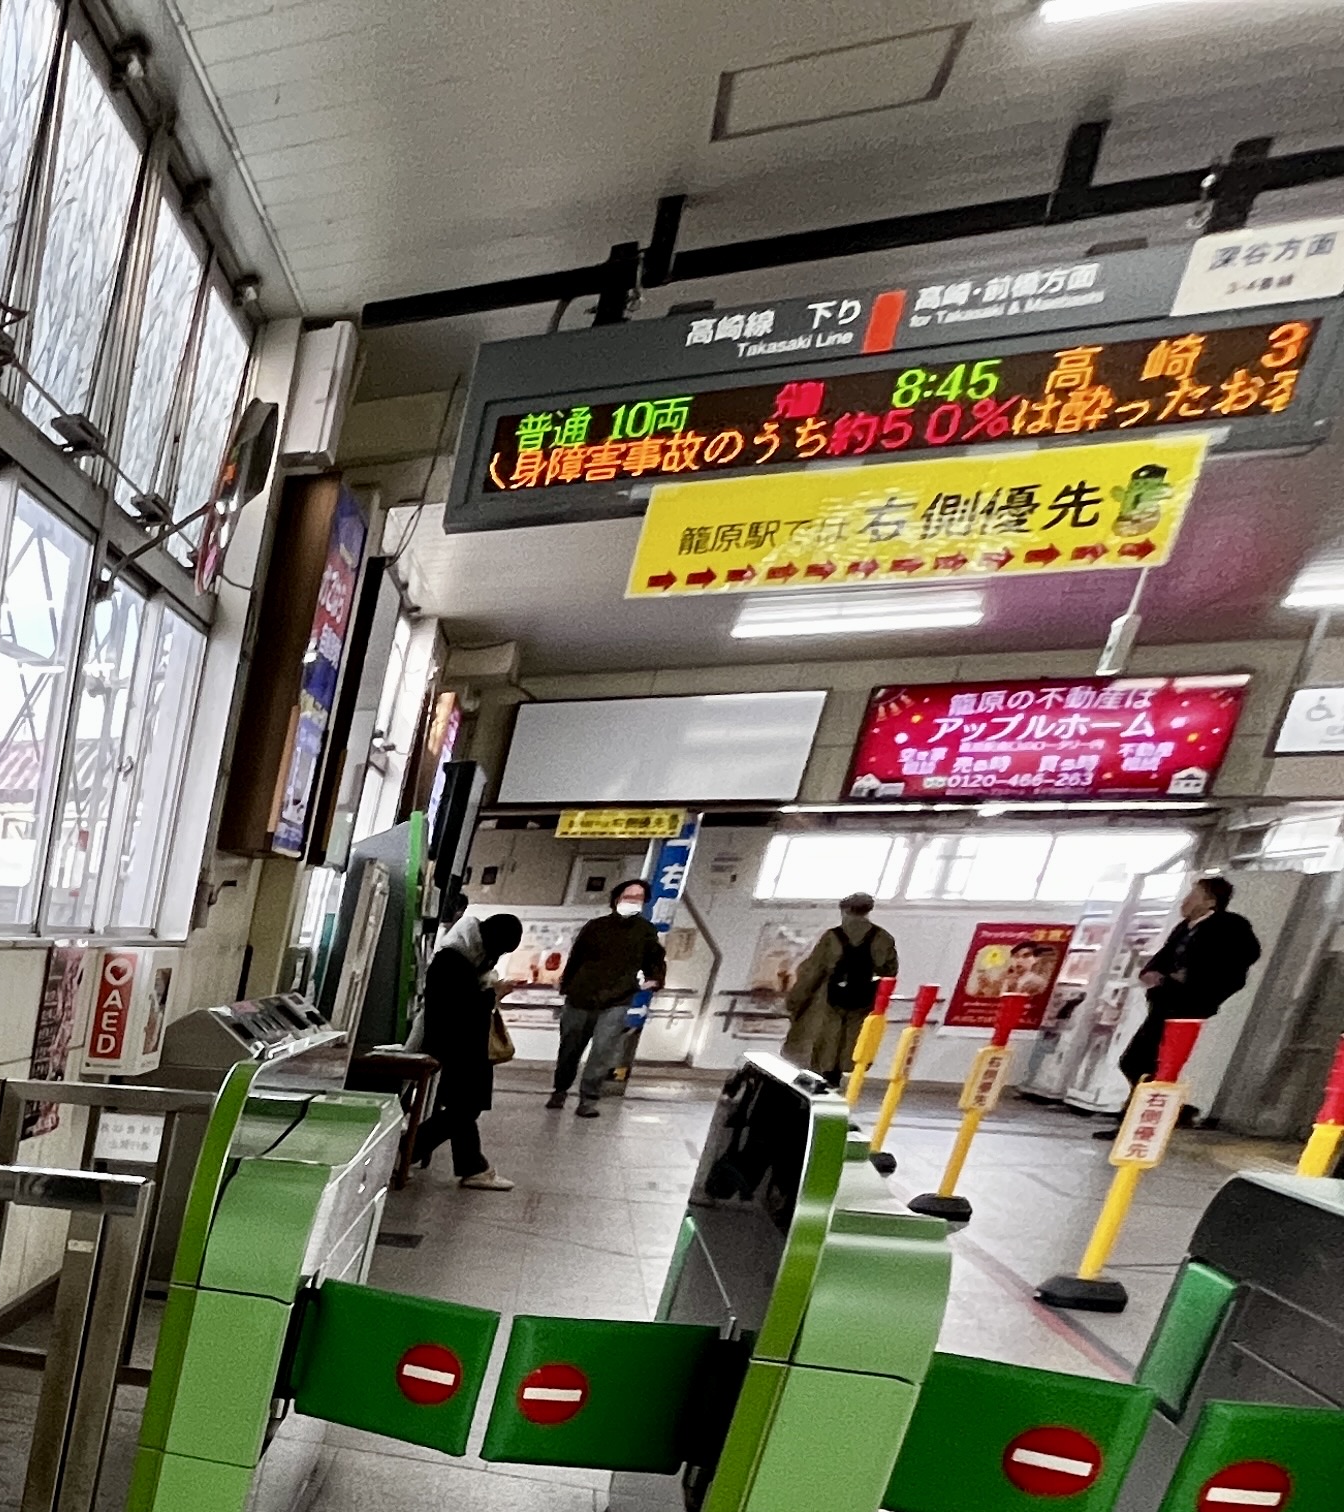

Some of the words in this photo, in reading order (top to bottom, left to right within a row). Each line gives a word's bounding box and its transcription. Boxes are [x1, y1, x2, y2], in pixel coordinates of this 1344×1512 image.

[685, 309, 776, 348] 高崎線
[807, 300, 861, 330] 下り
[736, 334, 812, 358] Takasaki
[815, 331, 855, 348] Line
[514, 407, 594, 453] 普通
[610, 395, 696, 440] 10両
[891, 358, 1004, 408] 8:45
[1260, 320, 1311, 369] 3
[947, 686, 1158, 718] 籠原の不動産は
[927, 711, 1157, 744] アップルホーム
[95, 988, 123, 1055] AED
